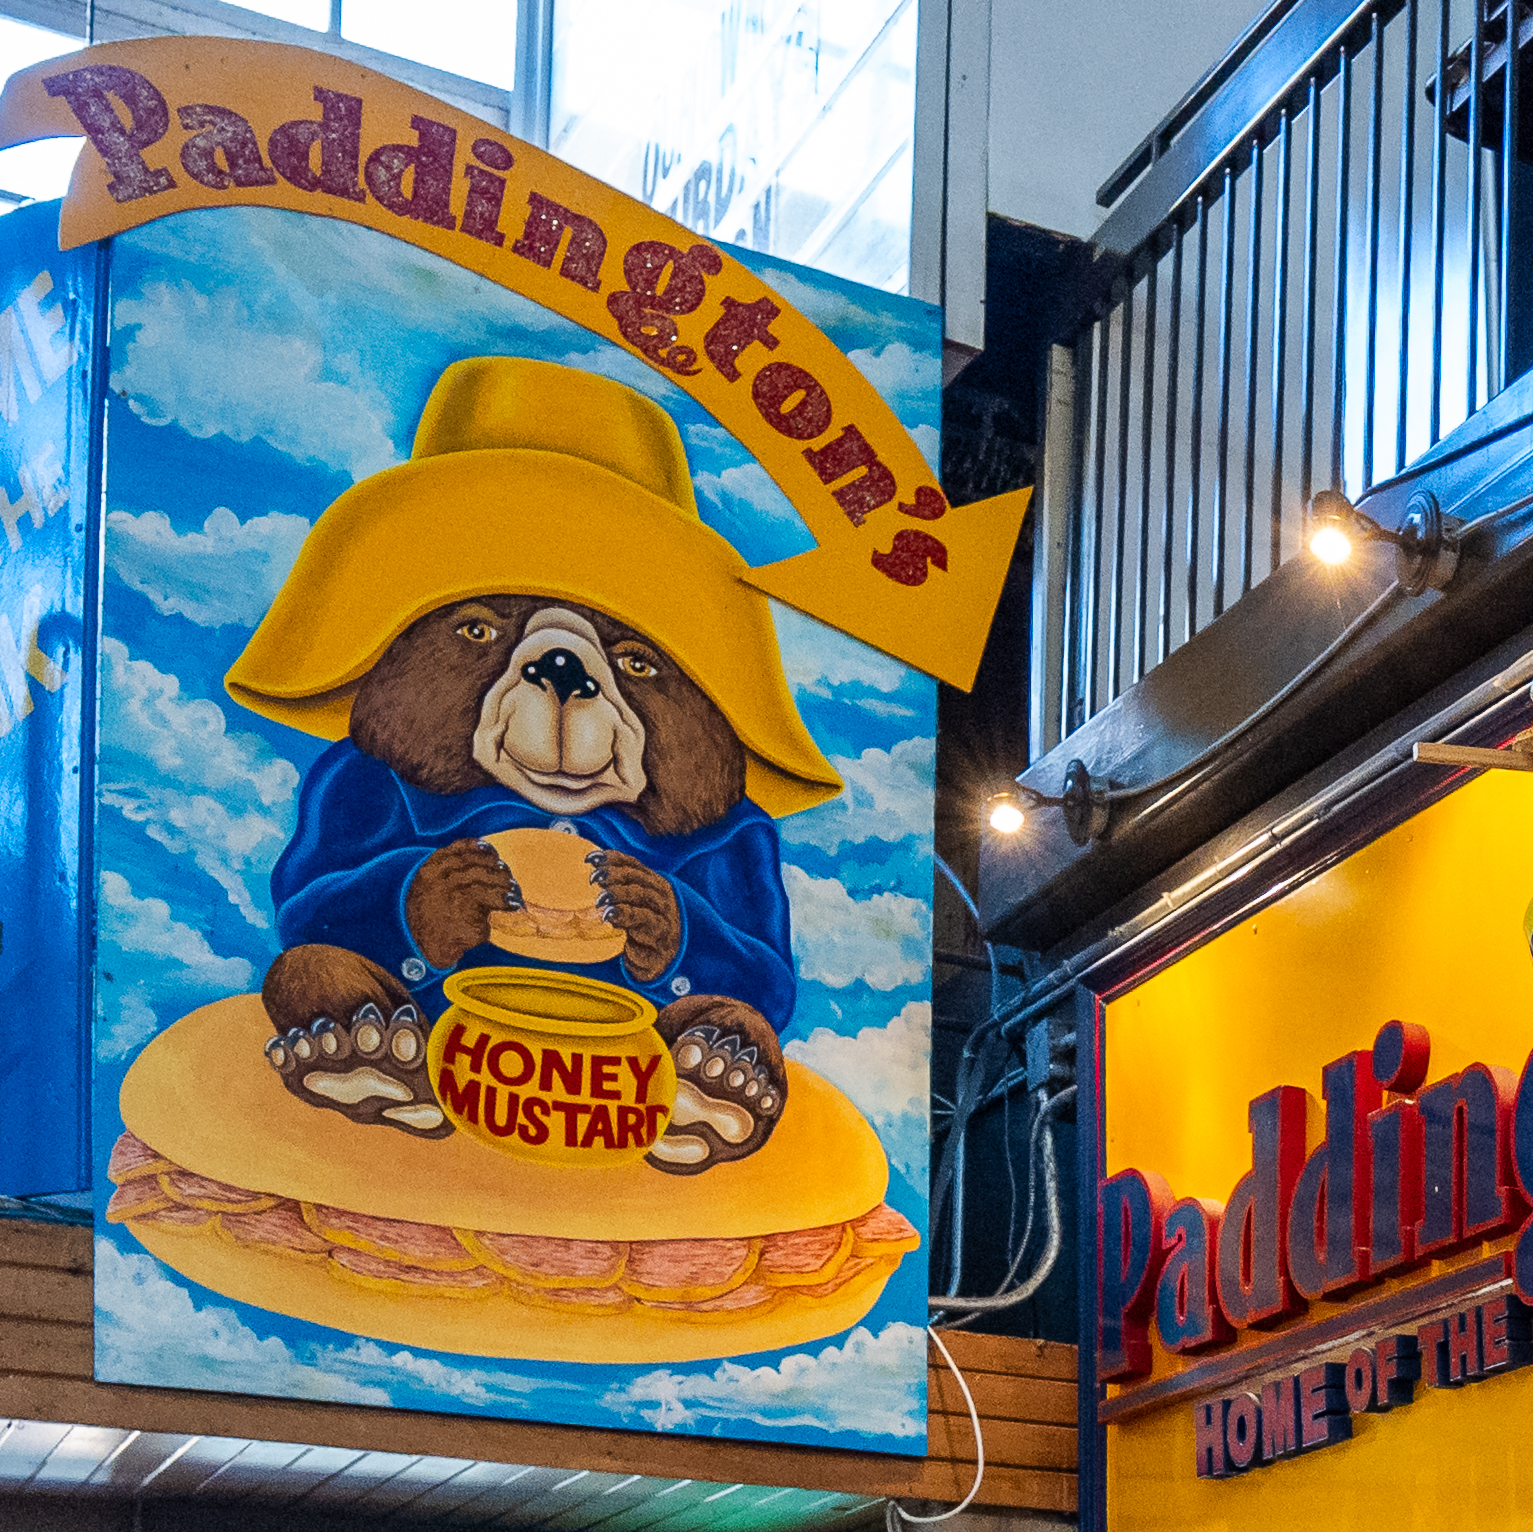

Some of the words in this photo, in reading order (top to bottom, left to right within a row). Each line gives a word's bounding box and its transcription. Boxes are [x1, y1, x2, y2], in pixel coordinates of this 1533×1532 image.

[41, 64, 950, 588] Paddington's
[437, 1070, 670, 1151] MUSTARD
[443, 1021, 664, 1107] HONEY
[1195, 1361, 1352, 1479] HOME
[1345, 1334, 1421, 1414] OF
